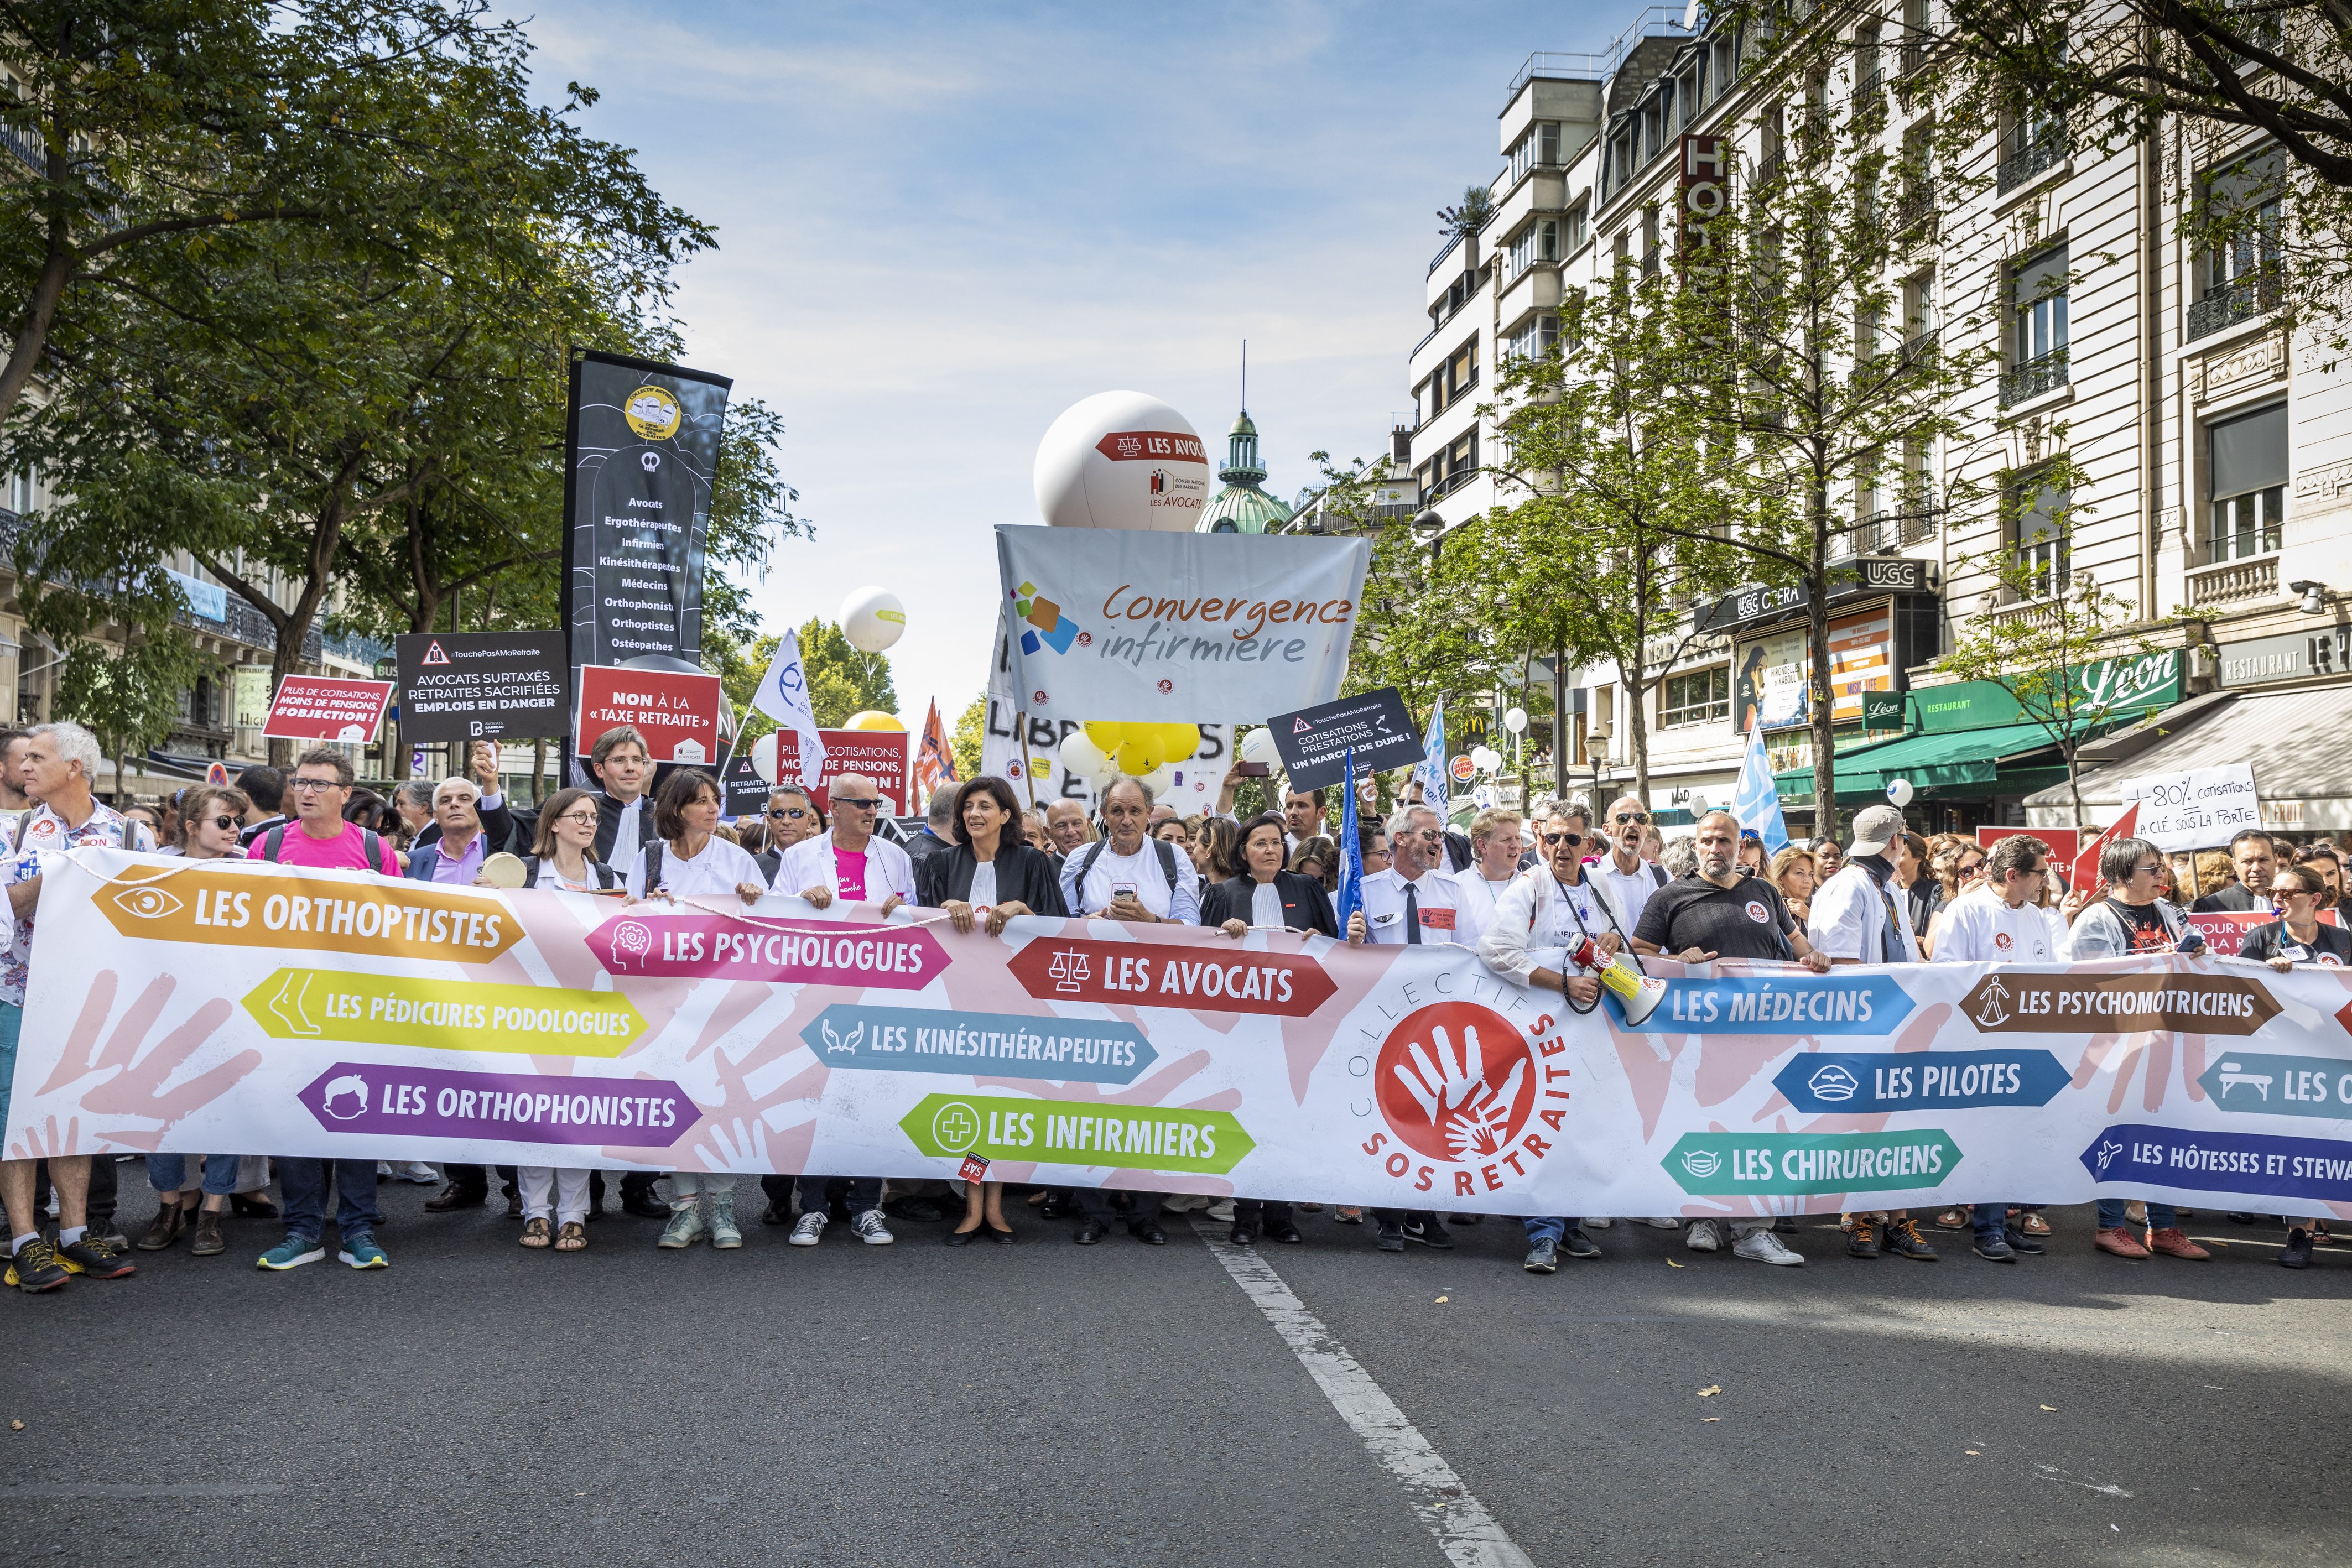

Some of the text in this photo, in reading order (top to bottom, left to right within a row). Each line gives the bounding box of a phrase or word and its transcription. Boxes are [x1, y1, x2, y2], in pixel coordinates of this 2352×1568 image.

[629, 388, 654, 400] COLLECTIF
[1148, 438, 1171, 454] LES
[628, 498, 663, 509] Avocats
[1163, 497, 1202, 509] AVOCATS
[605, 516, 682, 533] Ergothérapeutes
[622, 538, 664, 550] Infirmiers
[600, 556, 681, 572] Kinésithérapeutes
[1867, 562, 1915, 585] UGC
[622, 579, 668, 590] Médecins
[1102, 585, 1352, 640] Convergence
[1737, 592, 1758, 617] UGC
[612, 618, 674, 632] Orthoptistes
[611, 638, 673, 652] Ostéopathes
[1100, 621, 1307, 668] infirmière
[451, 649, 540, 658] #TouchePasAMaRetraite
[2225, 651, 2298, 681] RESTAURANT
[2306, 635, 2324, 669] LE
[377, 666, 397, 676] BUS
[417, 669, 550, 685] AVOCATS SURTAXÉS
[1771, 664, 1800, 678] HIRONDELLES
[1778, 674, 1797, 685] KABOUL
[284, 686, 304, 695] PLUS
[320, 689, 382, 701] COTISATIONS,
[408, 683, 560, 700] RETRAITES SACRIFIÉES
[1847, 678, 1877, 695] MUSIC LIFE
[279, 696, 378, 712] MOINS DE PENSIONS,
[415, 697, 555, 712] EMPLOIS EN DANGER
[612, 692, 689, 710] NON À LA
[1927, 700, 1970, 713] RESTAURANT
[275, 707, 367, 722] #OBJECTION
[600, 709, 699, 727] TAXE RETRAITE
[1313, 702, 1382, 725] #TouchePasAMaRetraite
[1298, 721, 1368, 746] COTISATIONS
[1301, 730, 1373, 754] PRESTATIONS
[827, 746, 902, 759] COTISATIONS,
[1292, 759, 1309, 770] UN
[1358, 742, 1373, 753] DE
[1374, 734, 1404, 749] DUPE
[825, 760, 902, 774] DE PENSIONS,
[1454, 760, 1474, 769] BURGER
[1455, 765, 1474, 776] KING
[2274, 803, 2304, 822] FRUIT
[2135, 824, 2146, 835] LA
[2150, 816, 2171, 834] CLÉ
[2200, 815, 2212, 827] LA
[195, 889, 503, 949] LES ORTHOPTISTES
[2193, 922, 2235, 934] POUR
[2211, 938, 2230, 949] LA
[664, 931, 923, 975] LES PSYCHOLOGUES
[1104, 956, 1294, 1003] LES AVOCATS
[1673, 982, 1874, 1022] LES MÉDECINS
[2018, 989, 2255, 1018] LES PSYCHOMOTRICIENS
[326, 991, 631, 1037] LES PÉDICURES PODOLOGUES
[871, 1023, 1136, 1066] LES KINÉSITHÉRAPEUTES
[1348, 972, 1528, 1117] COLLECTIF
[1875, 1063, 2021, 1100] LES PILOTES
[2283, 1070, 2327, 1102] LES
[382, 1083, 676, 1128] LES ORTHOPHONISTES
[1361, 1014, 1570, 1196] SOS RETRAITES
[987, 1111, 1216, 1159] LES INFIRMIERS
[1732, 1144, 1943, 1181] LES CHIRURGIENS
[2132, 1143, 2163, 1165] LES
[2169, 1144, 2260, 1174] HÔTESSES
[2266, 1154, 2288, 1175] ET
[964, 1162, 982, 1176] SAF
